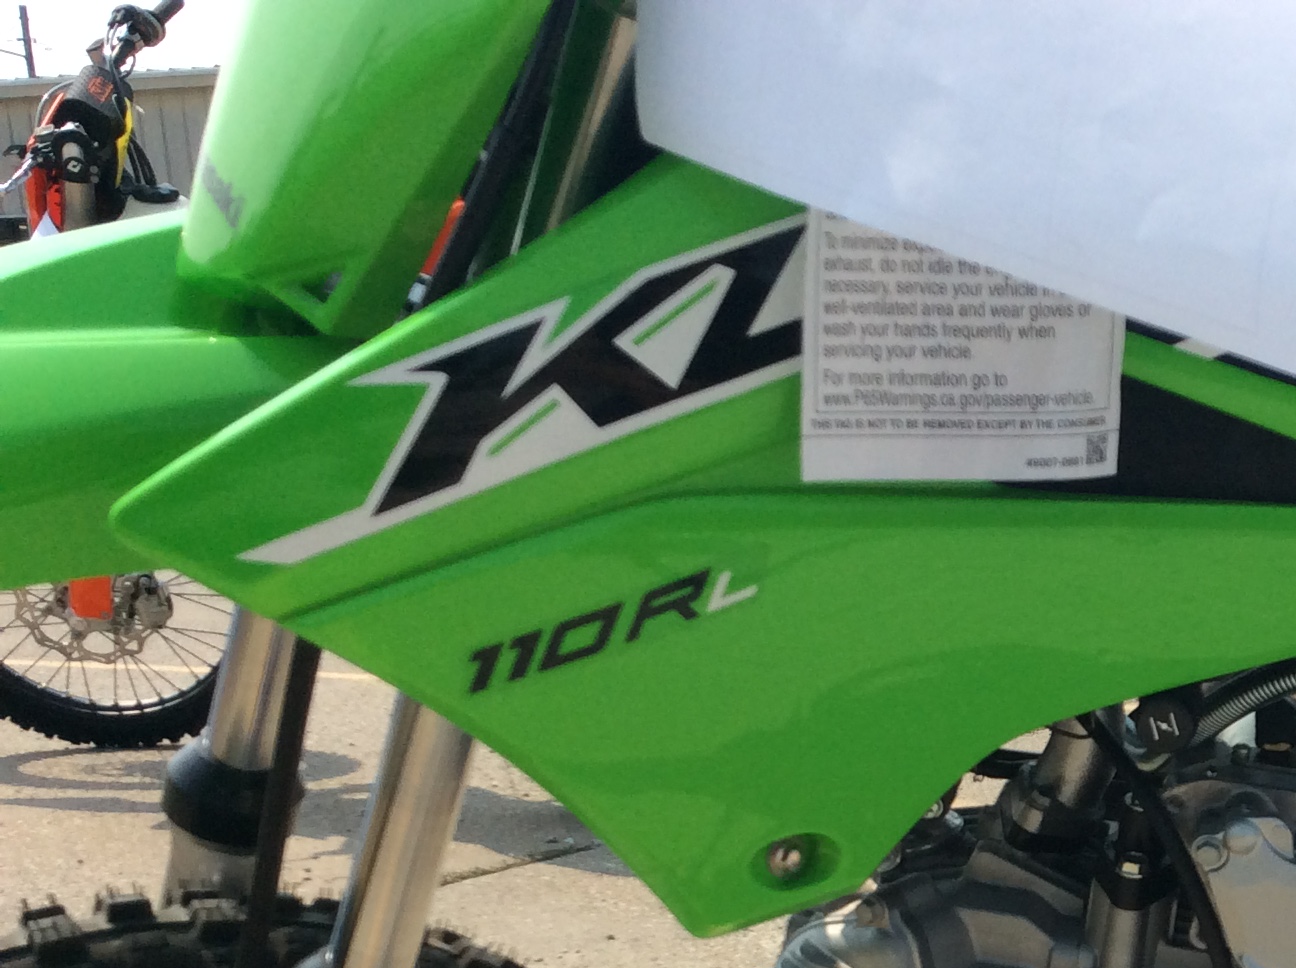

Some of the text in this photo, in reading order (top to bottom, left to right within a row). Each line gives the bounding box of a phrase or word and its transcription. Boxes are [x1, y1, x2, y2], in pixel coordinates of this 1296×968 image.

[841, 232, 899, 250] minimize
[880, 256, 898, 273] do
[902, 257, 924, 273] not
[928, 256, 954, 275] idle
[958, 258, 982, 276] the
[896, 279, 948, 296] service
[952, 281, 983, 300] your
[988, 278, 1038, 297] vehicle
[823, 299, 1093, 322] well-ventilated area and wear gloves or
[823, 321, 1056, 343] wash your hands frequently when
[823, 343, 882, 363] servicing
[886, 344, 917, 362] your
[823, 368, 1008, 391] For more information go to
[811, 417, 832, 430] THIS
[855, 417, 865, 430] IS
[867, 417, 887, 430] NOT
[889, 417, 904, 430] TO
[906, 417, 919, 430] BE
[922, 417, 974, 430] REMOVED
[977, 417, 1016, 430] EXCEPT
[1020, 417, 1033, 430] BY
[1036, 417, 1056, 430] THE
